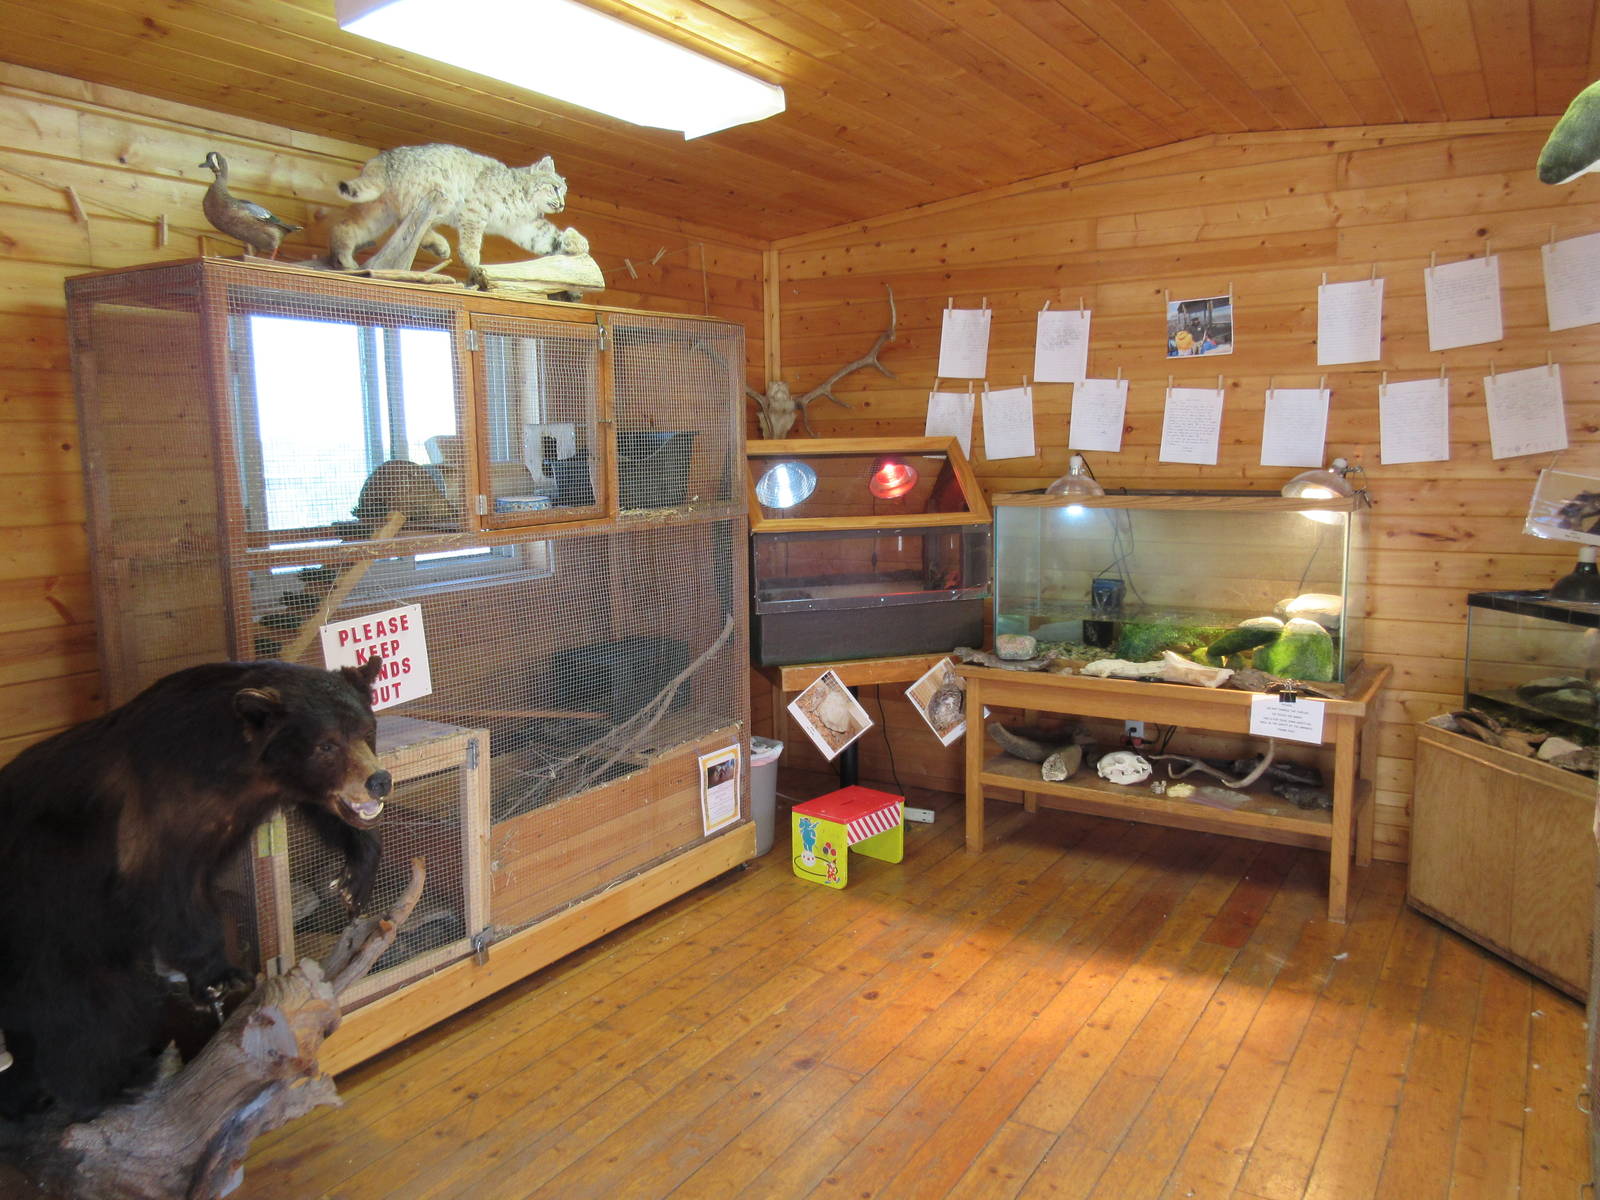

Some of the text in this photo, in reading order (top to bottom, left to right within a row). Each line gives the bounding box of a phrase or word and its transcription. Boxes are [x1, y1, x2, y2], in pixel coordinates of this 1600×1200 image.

[338, 614, 410, 647] PLEASE
[355, 639, 401, 666] KEEP
[376, 657, 411, 682] NDS
